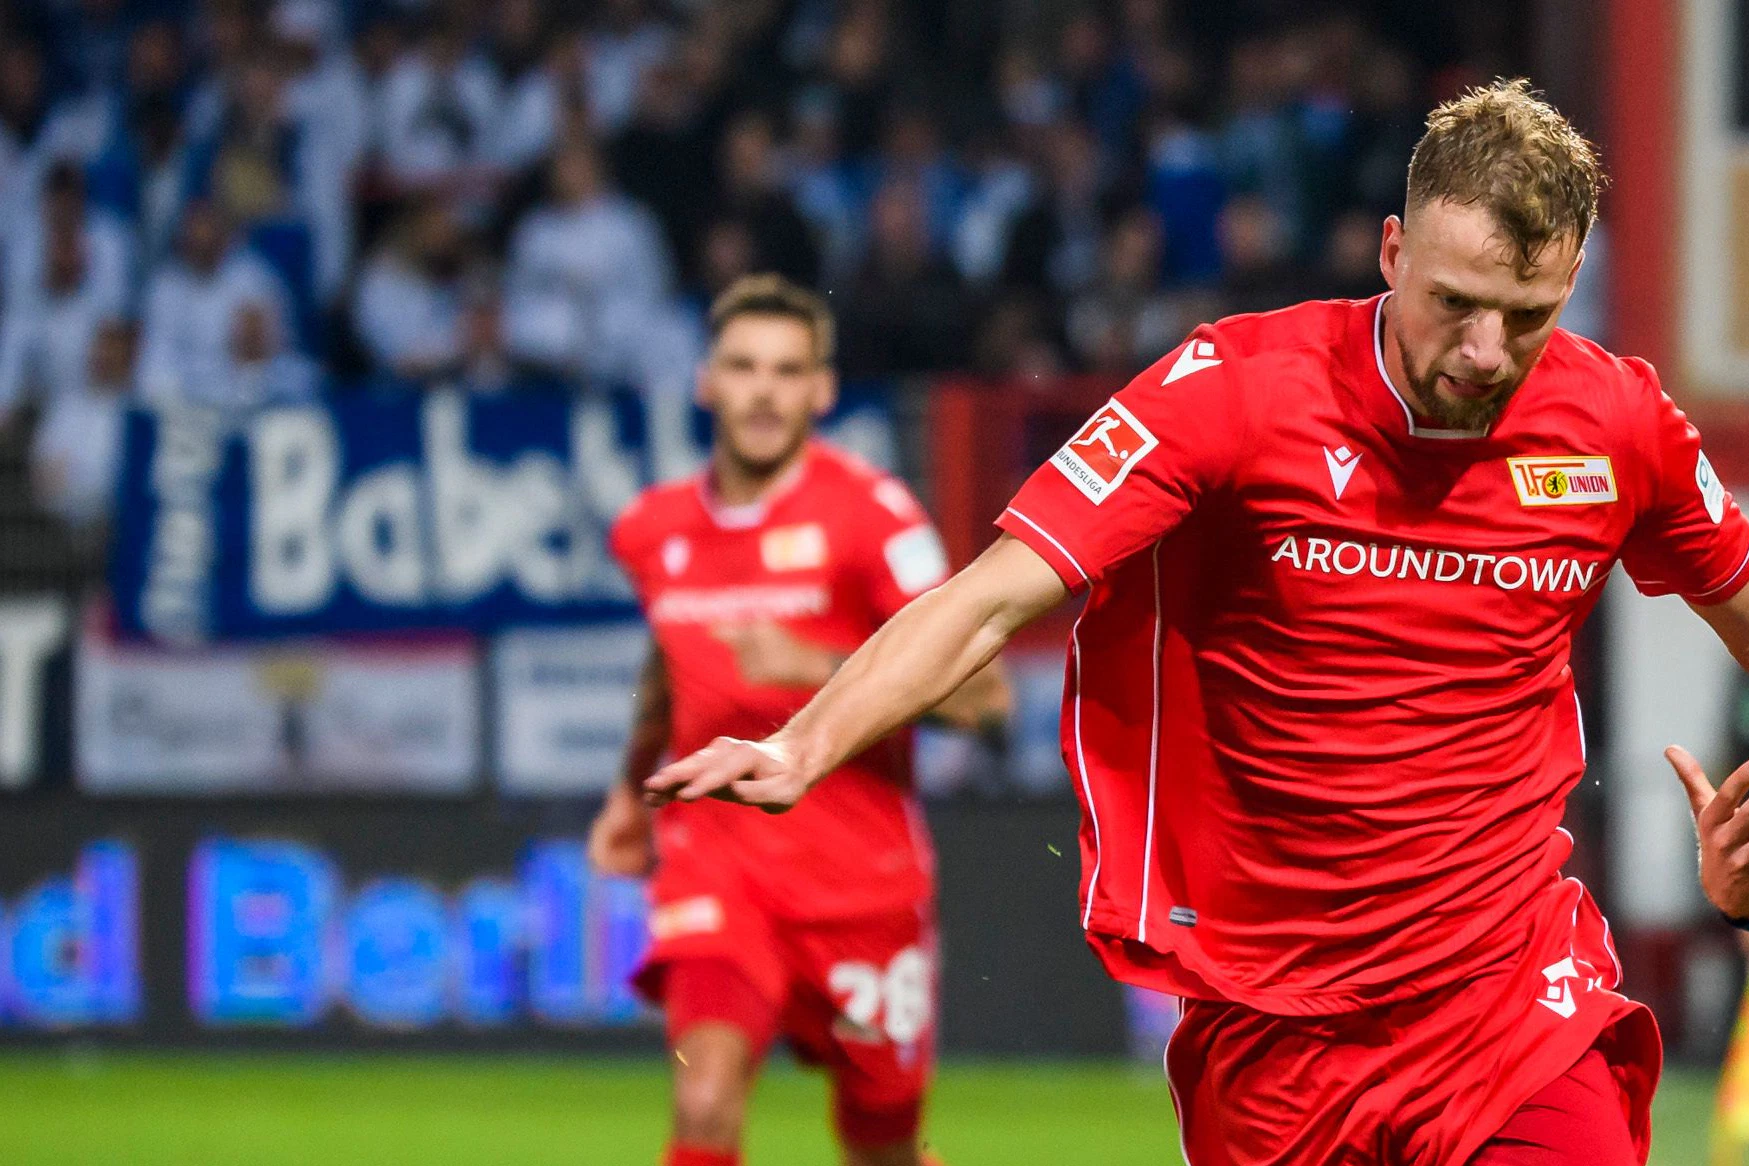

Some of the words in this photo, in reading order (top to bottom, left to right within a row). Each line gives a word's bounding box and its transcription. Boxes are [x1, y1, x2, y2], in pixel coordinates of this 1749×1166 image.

[1056, 449, 1103, 495] BUNDESLIGA
[1568, 475, 1610, 493] UNION
[1271, 535, 1598, 592] AROUNDTOWN
